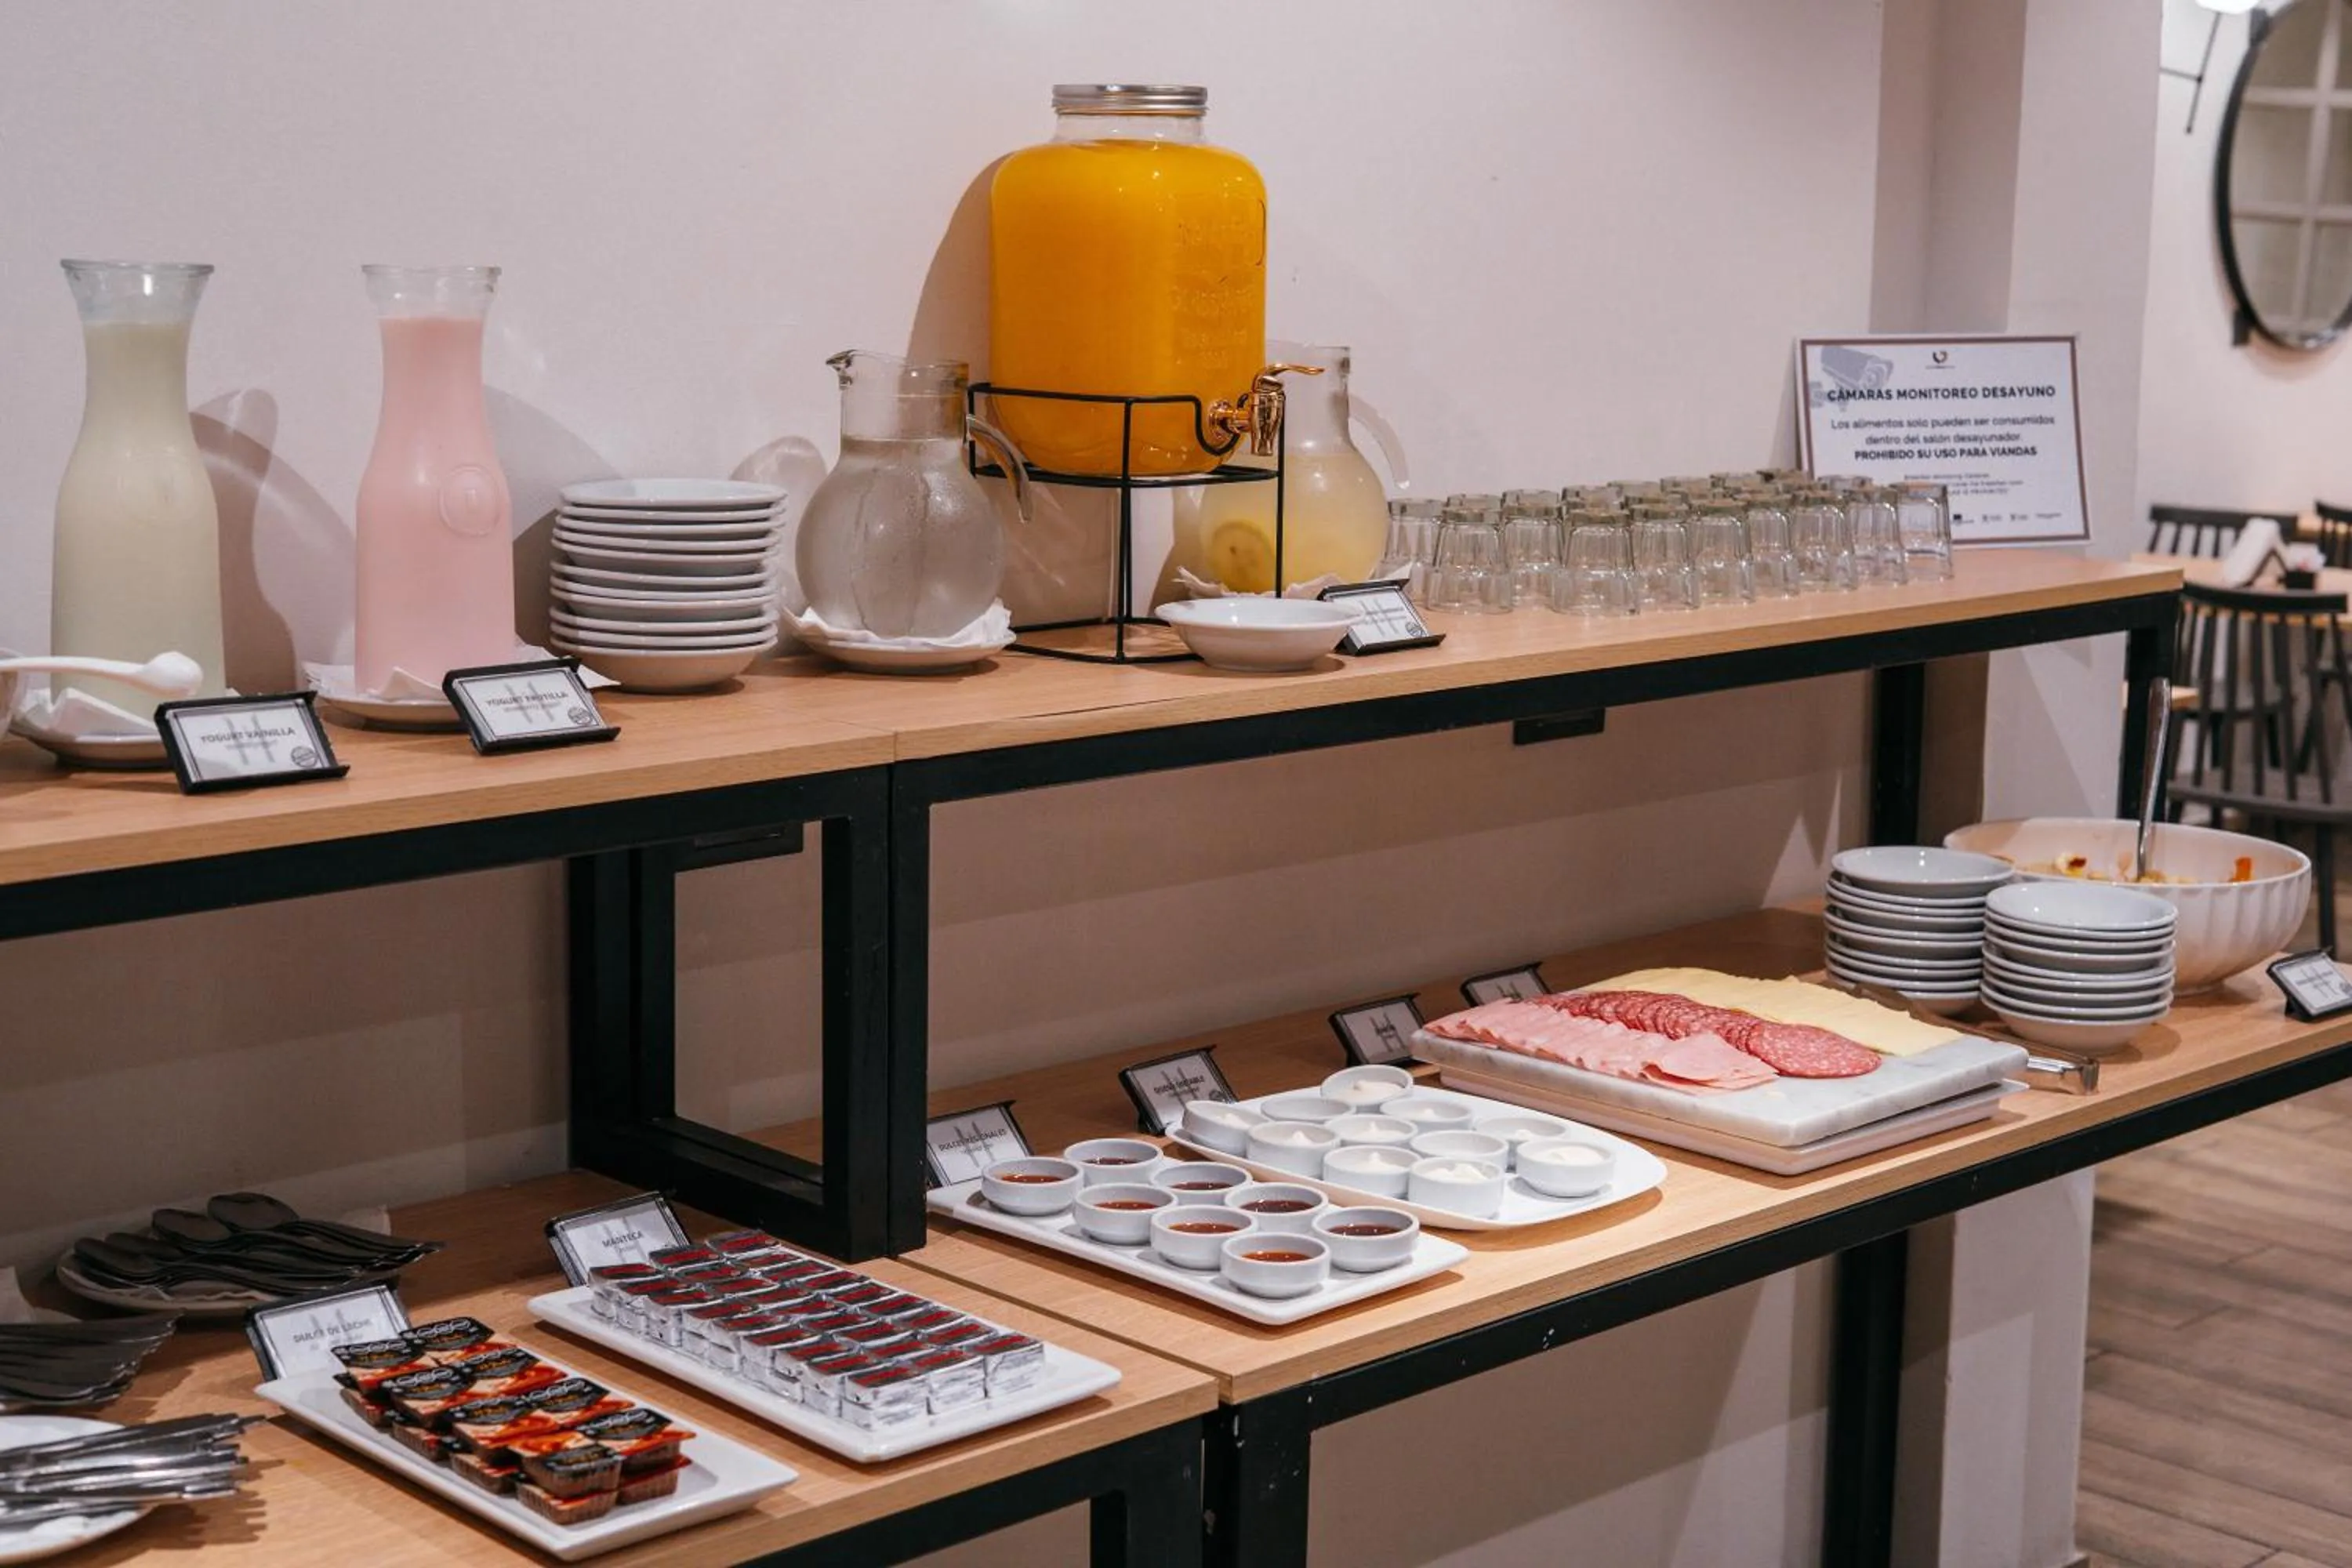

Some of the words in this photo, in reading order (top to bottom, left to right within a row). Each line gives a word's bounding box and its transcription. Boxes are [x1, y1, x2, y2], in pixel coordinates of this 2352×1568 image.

[1827, 387, 1893, 401] CÁMARAS
[1896, 387, 1978, 400] MONITOREO
[1982, 385, 2056, 398] DESAYUNO
[1831, 419, 1849, 429] Los
[1853, 418, 1904, 429] alimentos
[1931, 416, 1971, 429] pueden
[1992, 415, 2055, 426] consumidos
[1865, 435, 1900, 445] dentro
[1903, 434, 1920, 445] del
[1854, 449, 1915, 461] PROHIBIDO
[1918, 449, 1931, 459] SU
[1934, 448, 1957, 459] USO
[1960, 448, 1987, 458] PARA
[1990, 445, 2038, 457] VIANDAS
[201, 731, 243, 743] YOGURT
[601, 1230, 644, 1247] MANTECA
